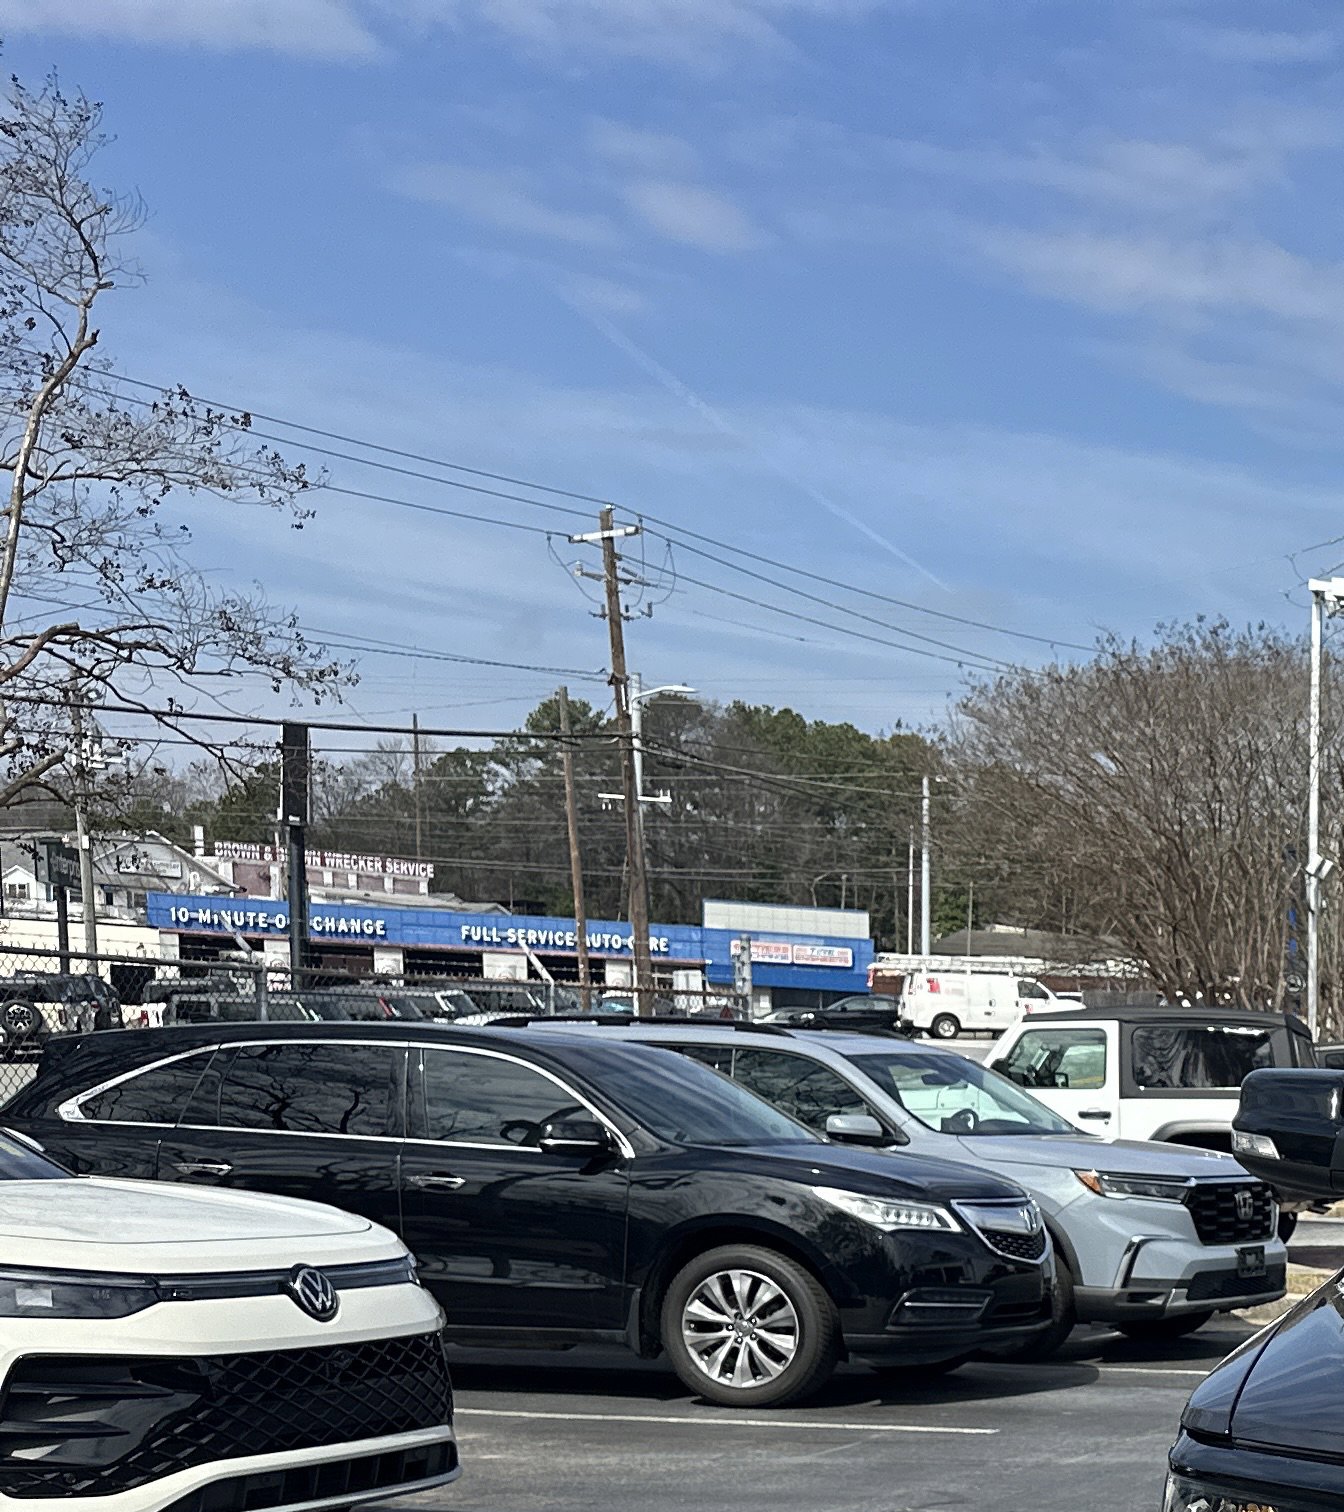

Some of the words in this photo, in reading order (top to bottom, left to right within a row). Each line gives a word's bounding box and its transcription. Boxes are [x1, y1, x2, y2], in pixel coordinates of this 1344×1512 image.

[214, 841, 260, 860] BROWN
[263, 845, 273, 861] &
[276, 847, 321, 866] BWN
[324, 852, 382, 872] WRECKER
[385, 858, 434, 878] SERVICE
[311, 916, 386, 936] CHANGE
[461, 925, 501, 943] FULL
[507, 928, 575, 947] SERVICE
[627, 937, 669, 952] CRE
